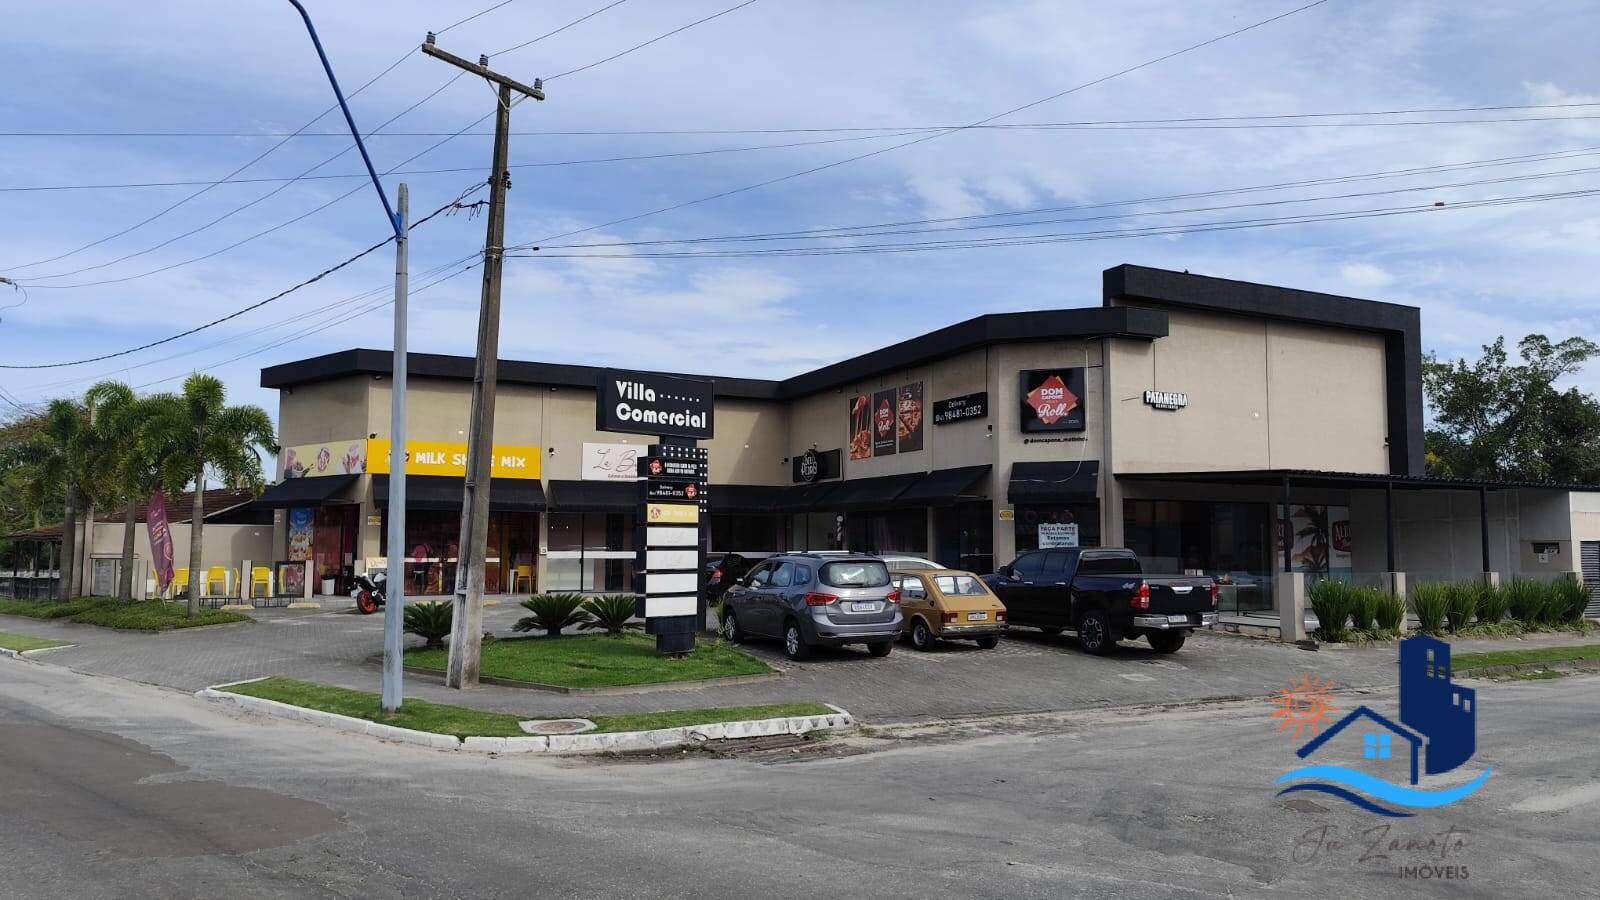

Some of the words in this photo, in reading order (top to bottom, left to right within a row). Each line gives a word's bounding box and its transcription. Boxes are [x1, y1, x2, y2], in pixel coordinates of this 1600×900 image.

[616, 380, 656, 402] Villa
[1041, 388, 1063, 396] DOM
[1146, 391, 1188, 406] PATANEGRA
[616, 402, 706, 428] Comercial
[415, 452, 446, 465] MILK
[501, 455, 526, 468] MIX
